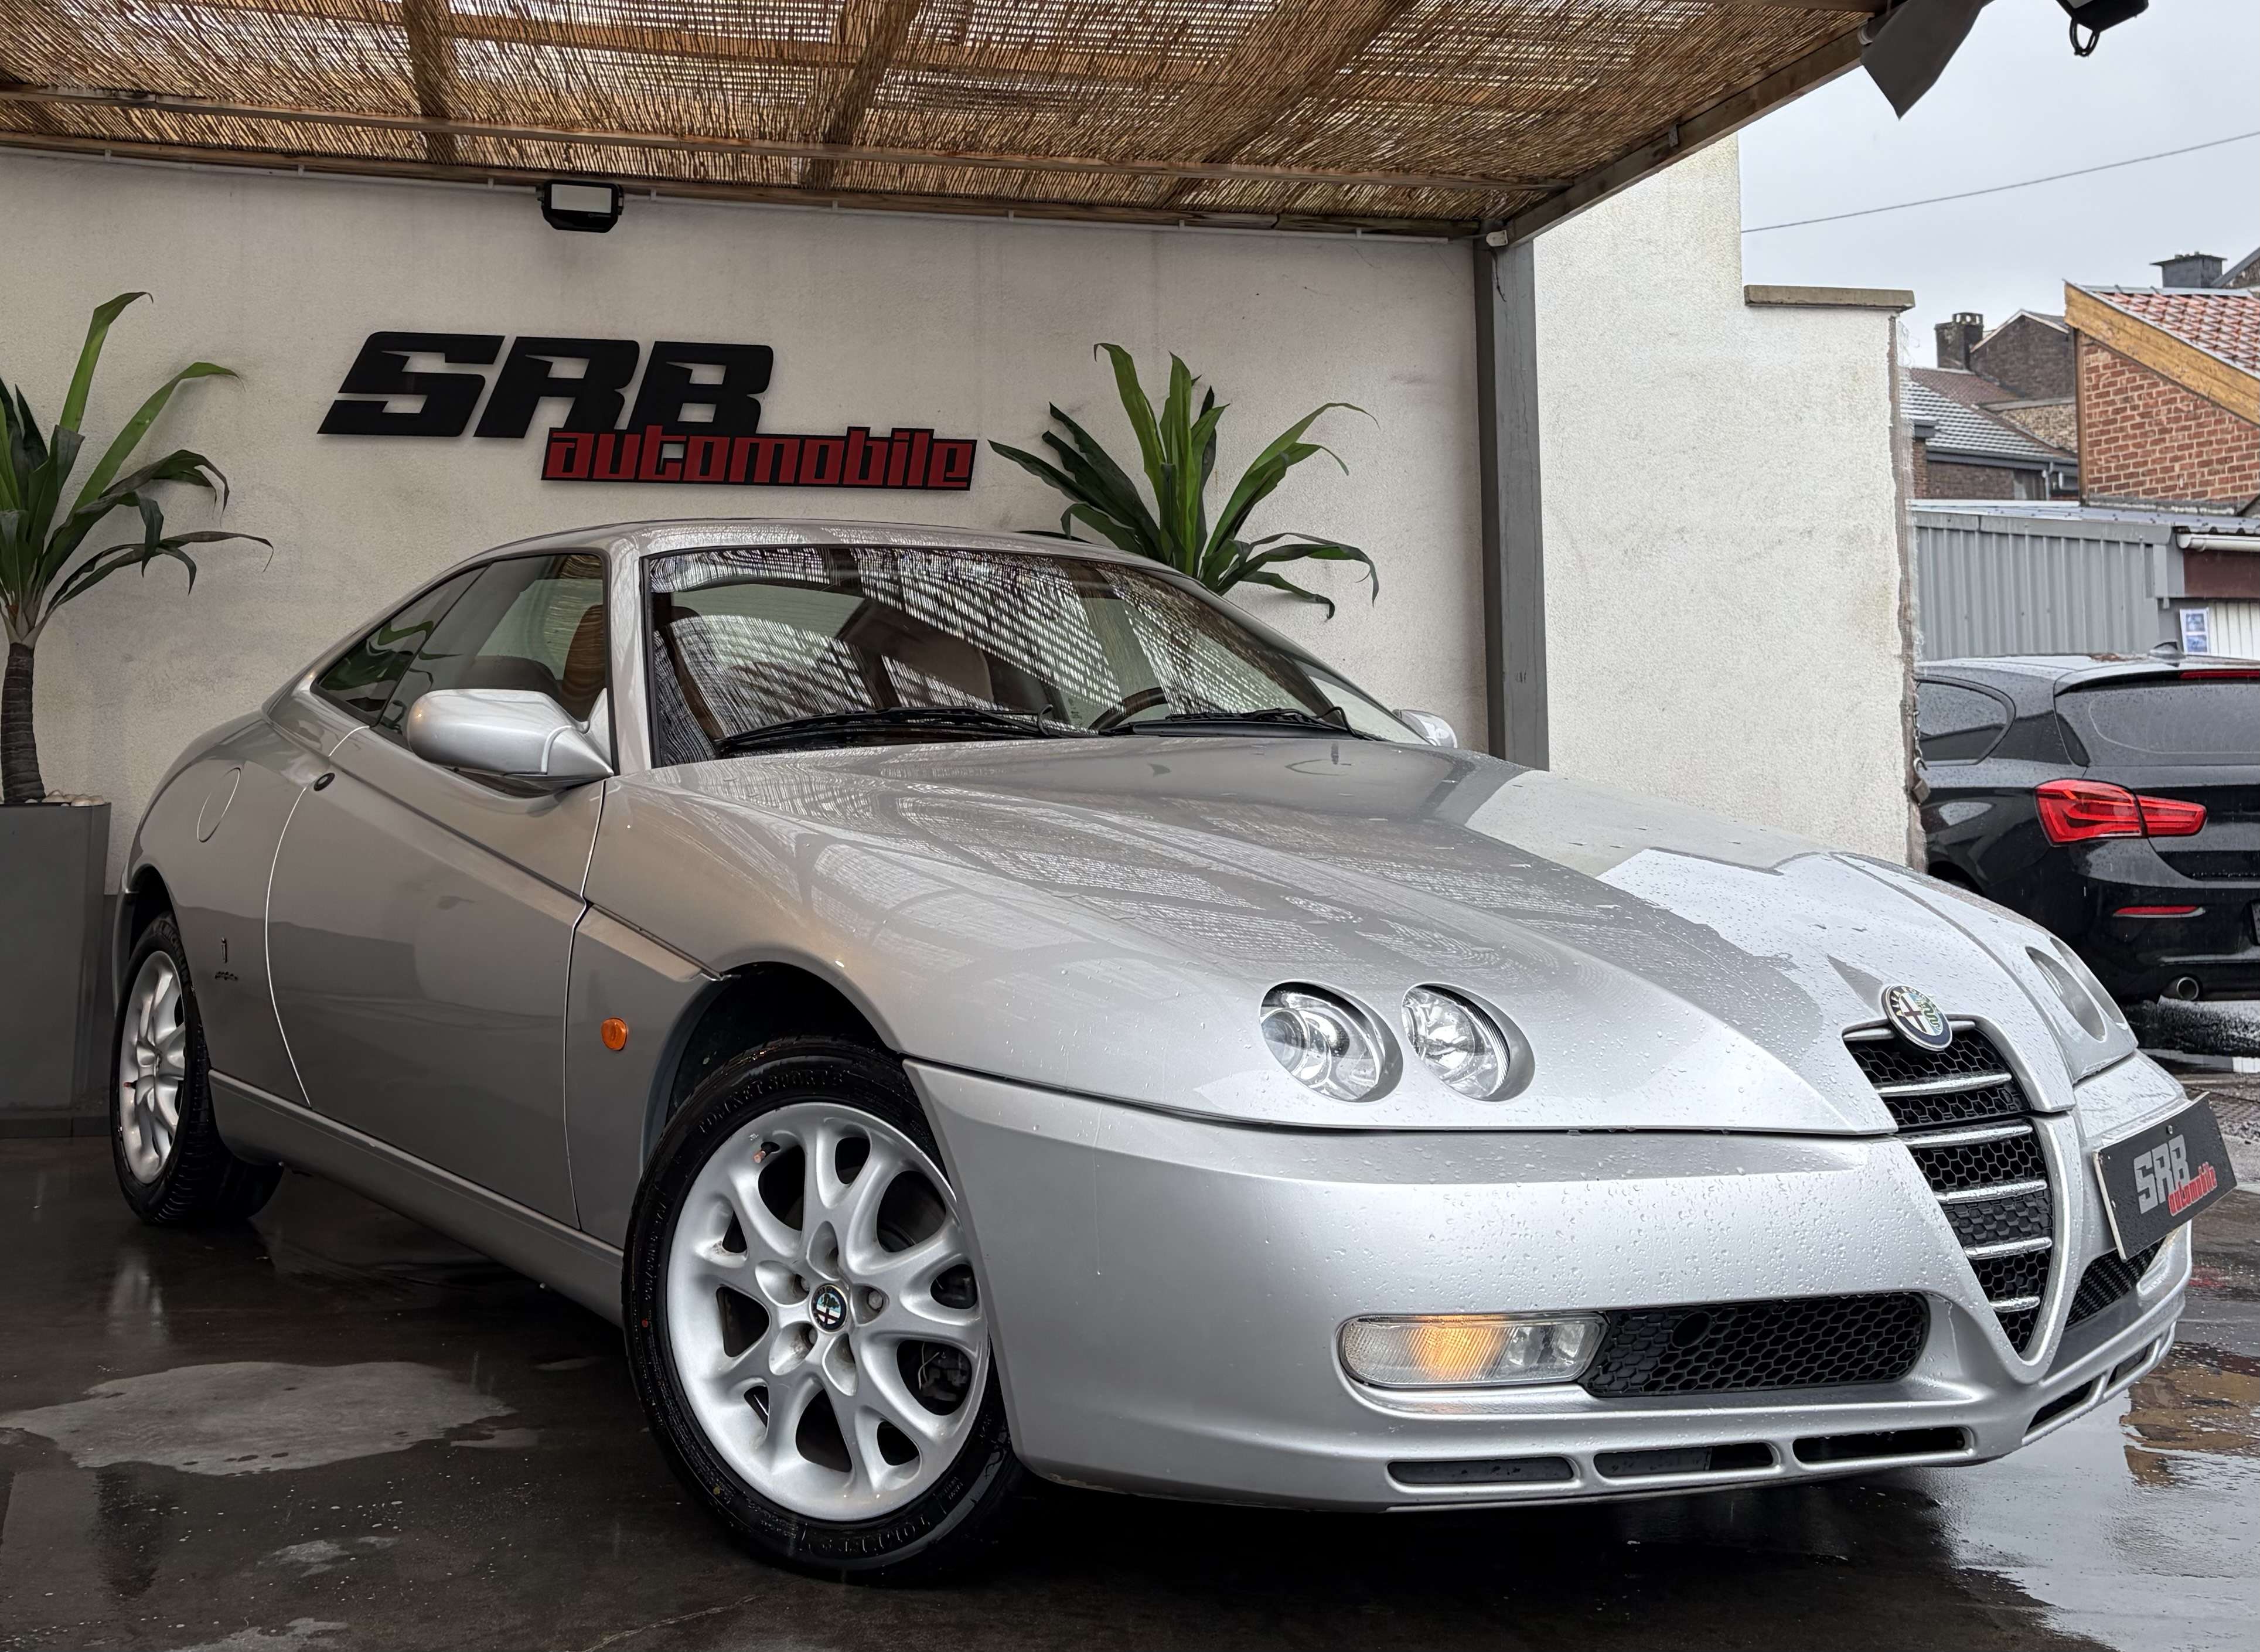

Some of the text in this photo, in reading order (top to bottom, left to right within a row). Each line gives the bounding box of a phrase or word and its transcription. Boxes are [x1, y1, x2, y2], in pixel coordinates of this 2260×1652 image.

[317, 331, 773, 438] SRB
[543, 425, 976, 490] automobile
[2133, 1135, 2190, 1214] SRB
